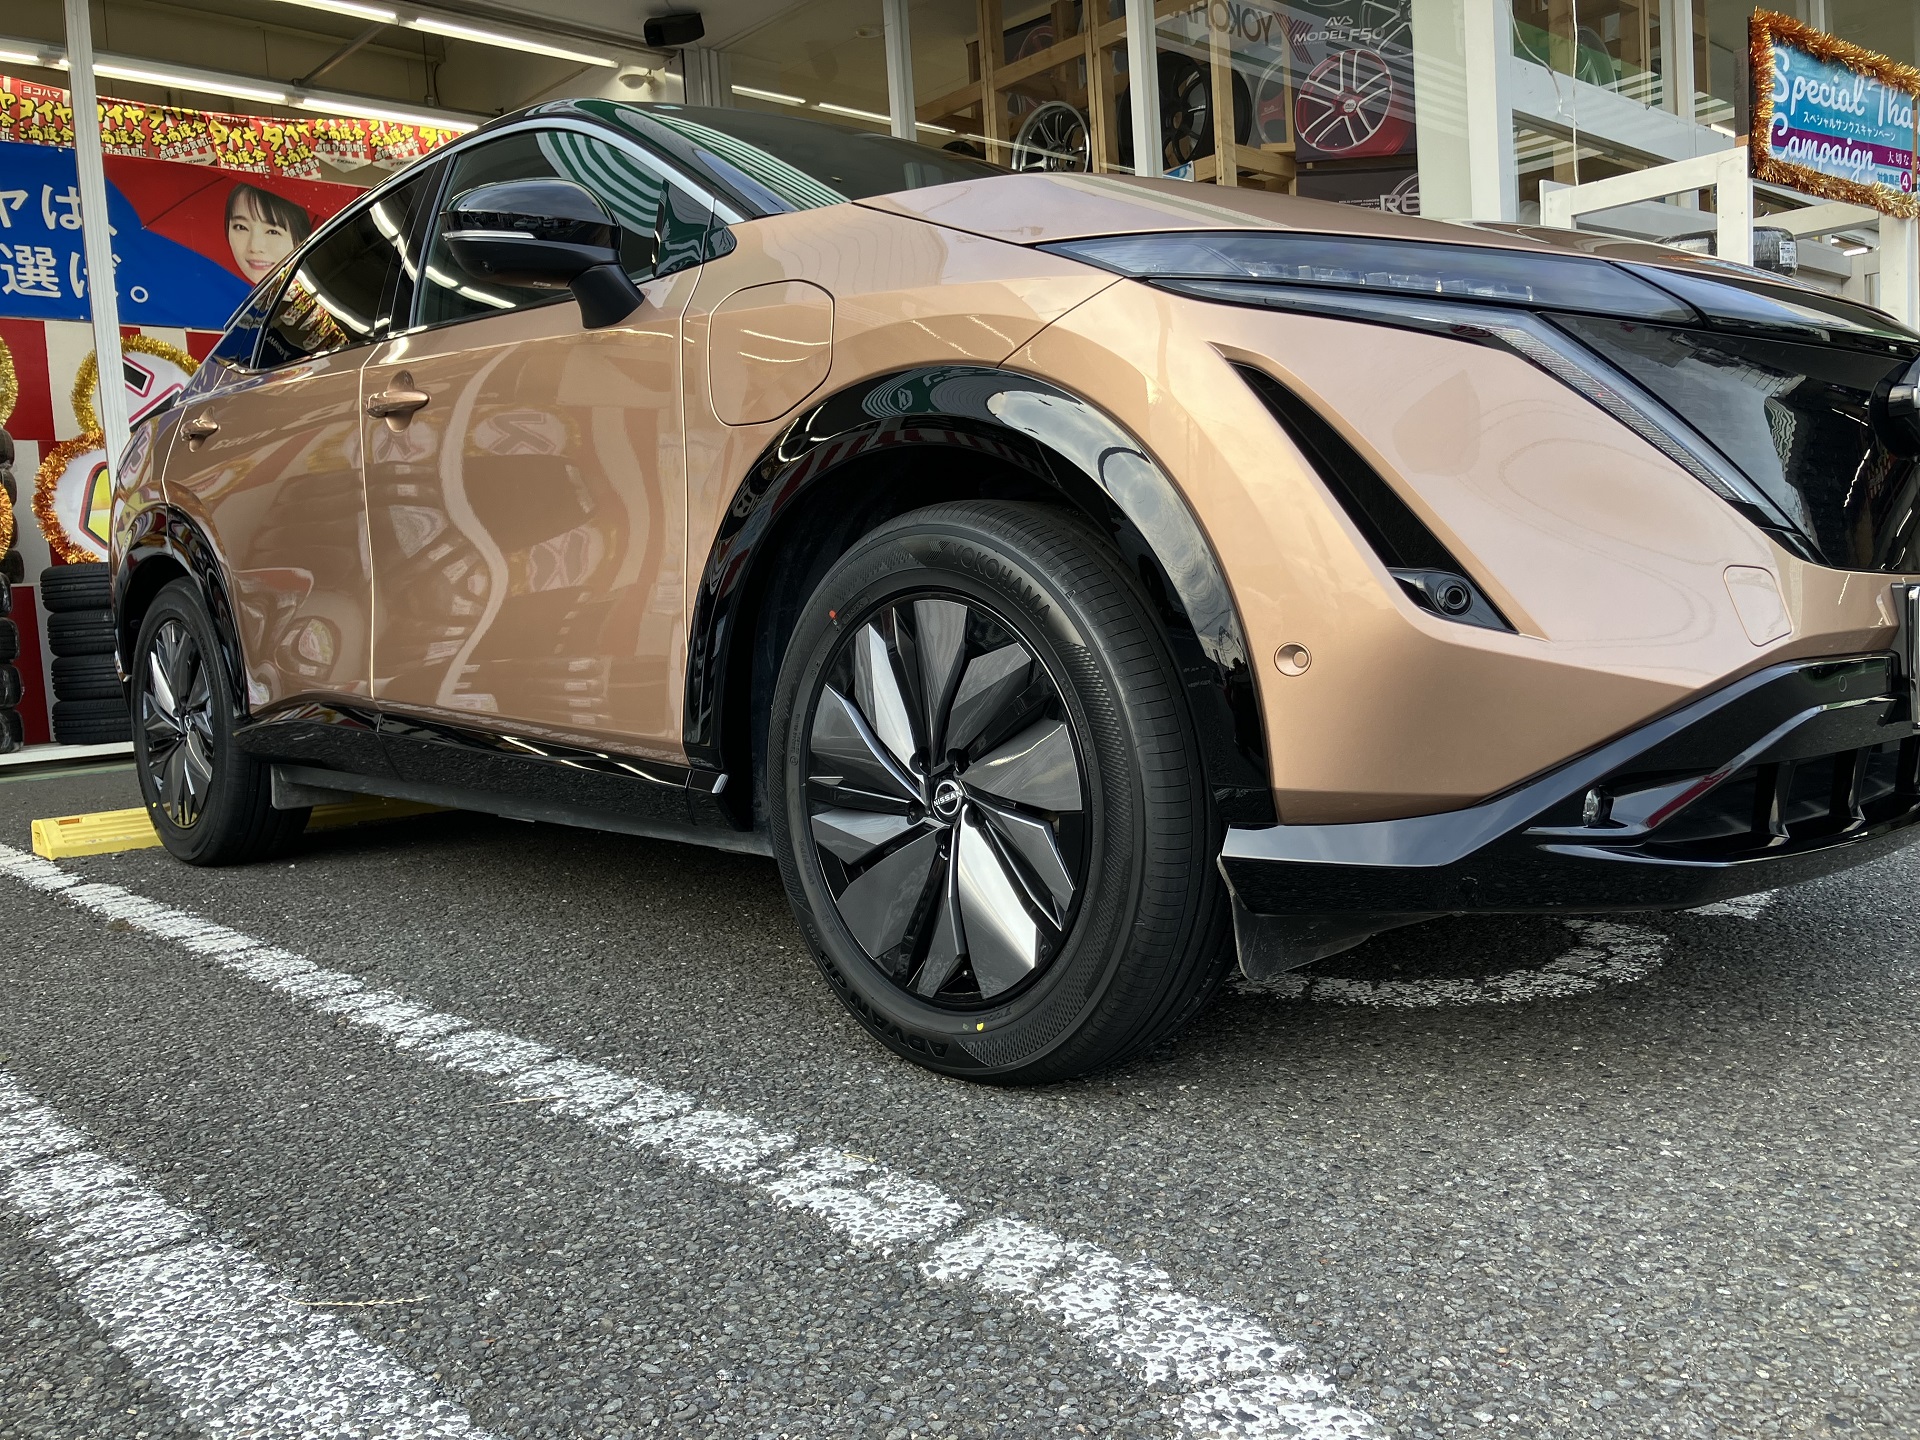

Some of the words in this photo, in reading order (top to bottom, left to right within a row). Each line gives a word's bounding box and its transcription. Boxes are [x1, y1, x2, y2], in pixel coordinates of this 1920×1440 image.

[1293, 30, 1346, 43] MODEL
[1348, 27, 1386, 42] F50
[1325, 15, 1353, 27] AVS
[22, 85, 61, 99] ヨコハマ
[1771, 46, 1865, 117] Special
[1867, 78, 1918, 132] Tha
[1803, 111, 1897, 142] スペシャルサンクスキャンペーン
[1769, 112, 1875, 184] Campaign
[951, 542, 1051, 628] YOKOHAMA
[933, 790, 963, 807] NISSAN
[850, 991, 950, 1059] ADVAN
